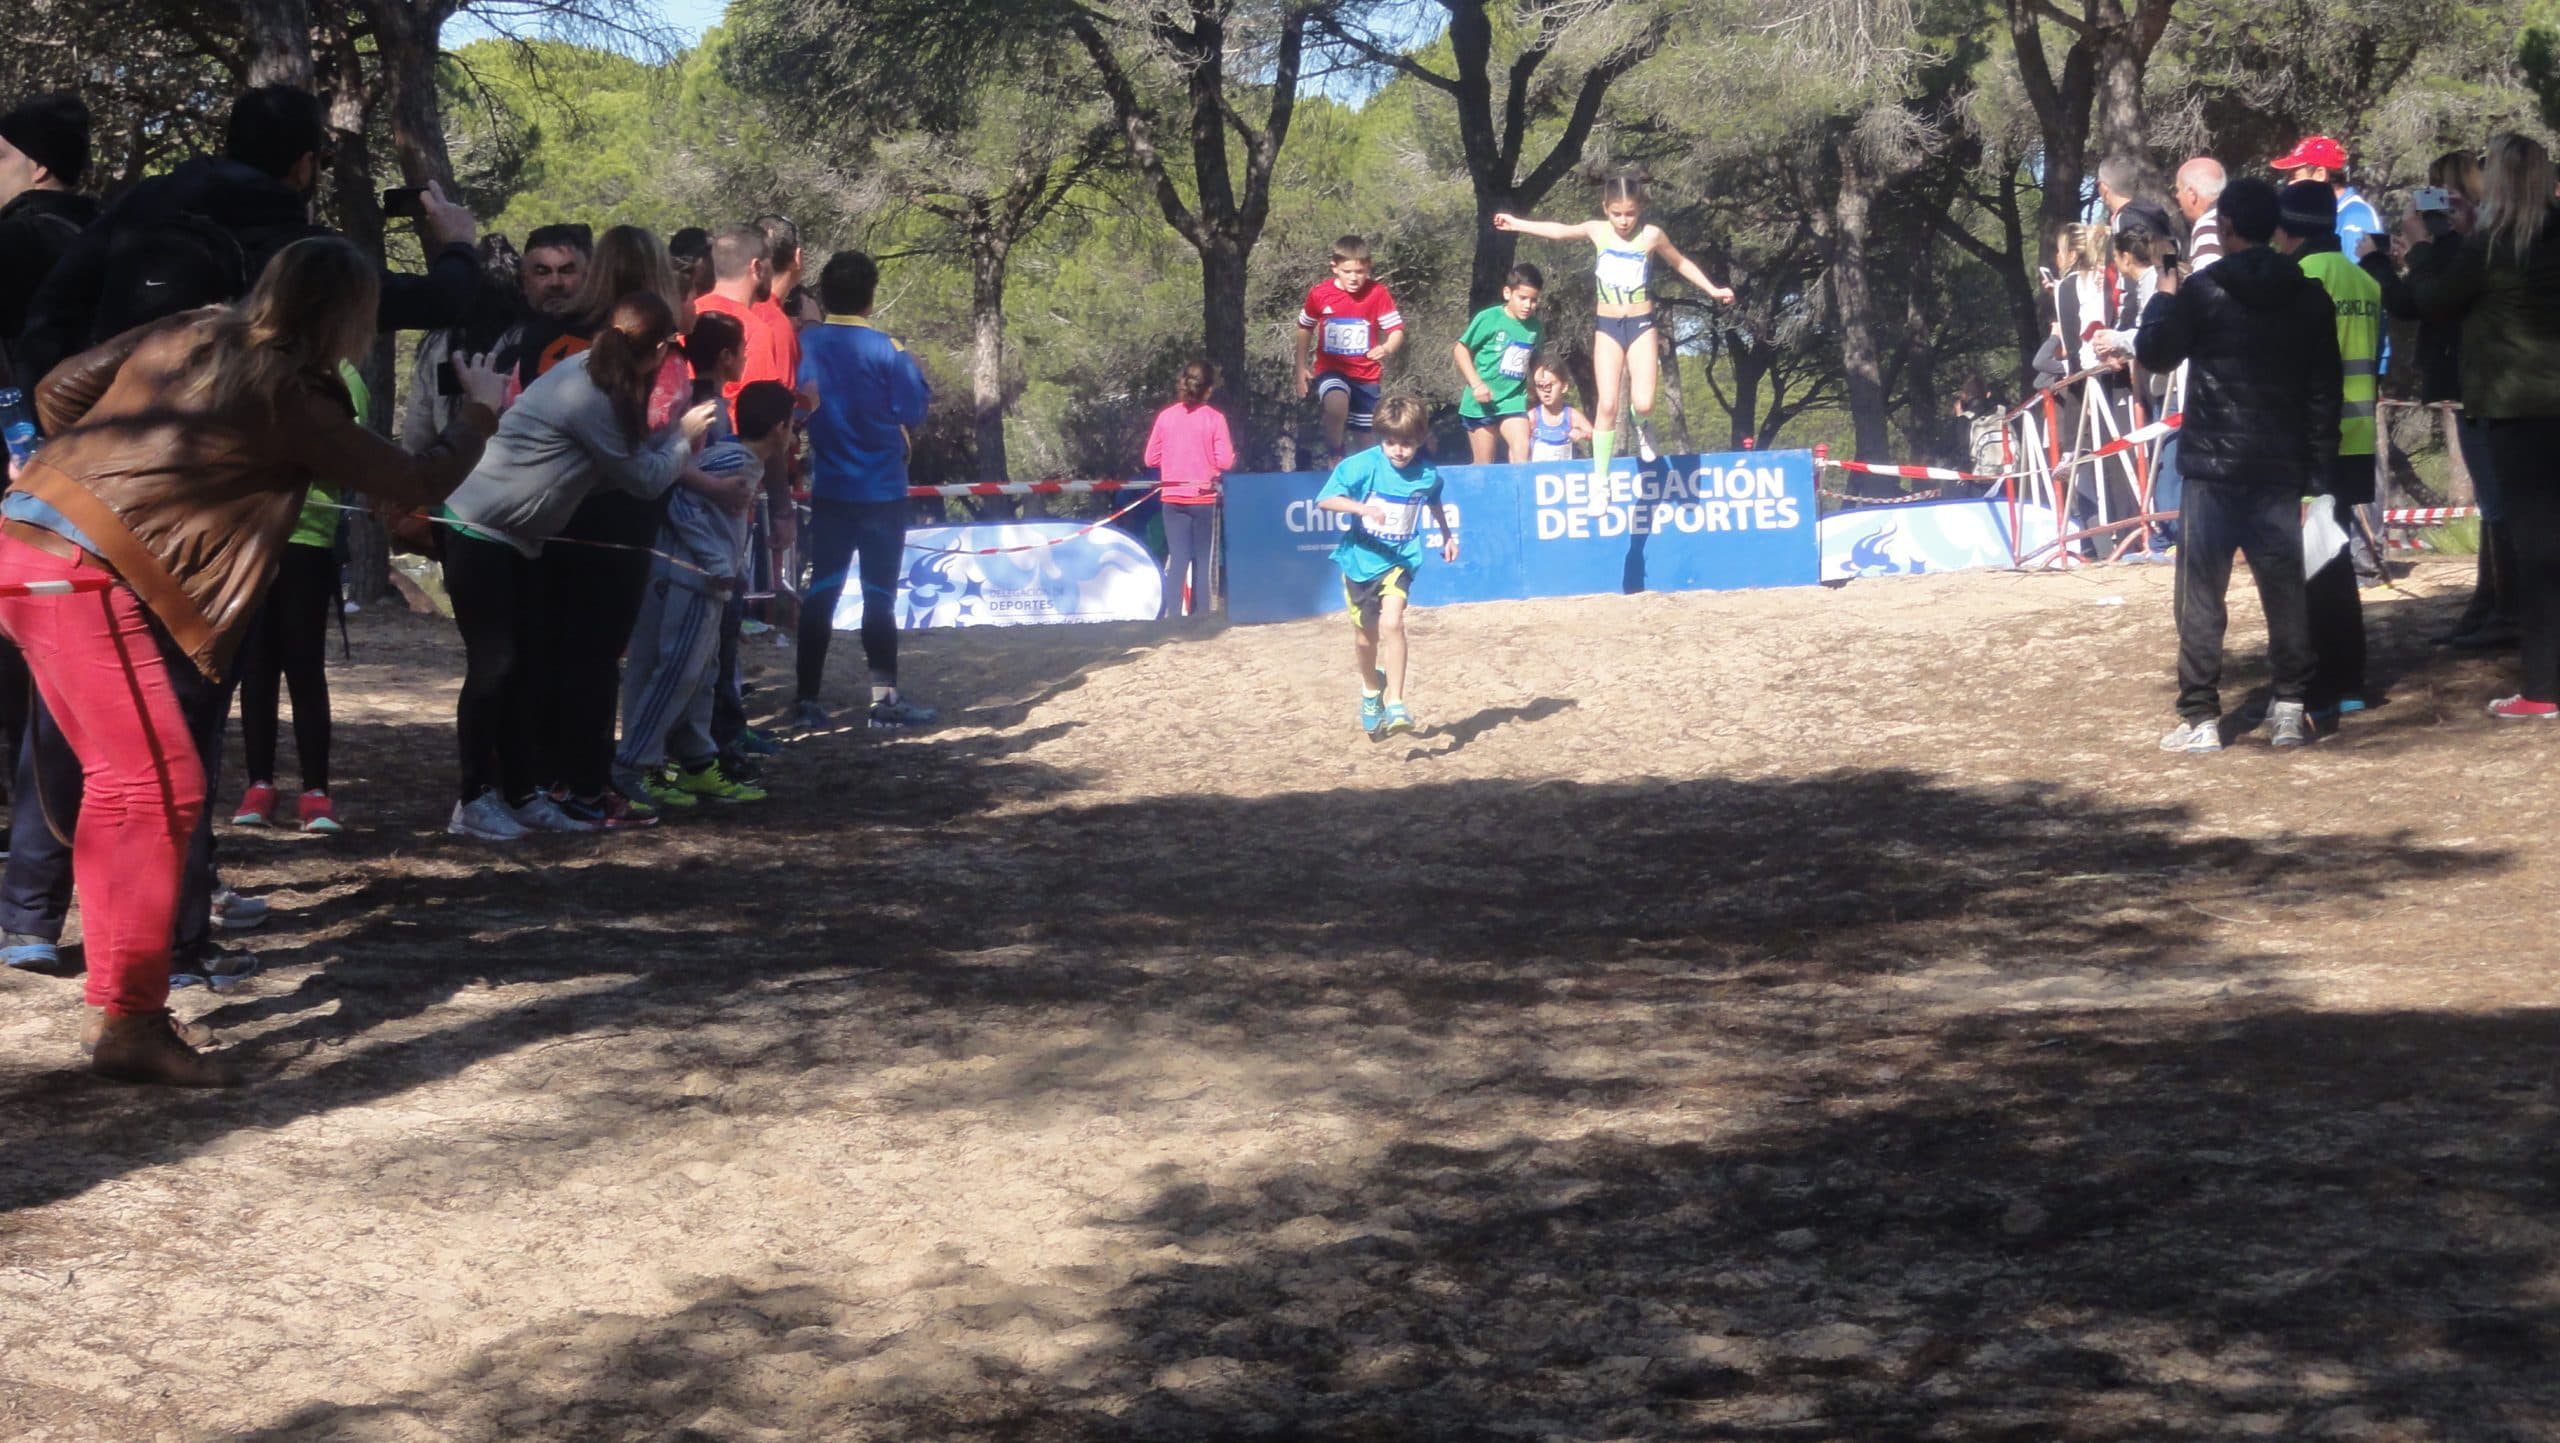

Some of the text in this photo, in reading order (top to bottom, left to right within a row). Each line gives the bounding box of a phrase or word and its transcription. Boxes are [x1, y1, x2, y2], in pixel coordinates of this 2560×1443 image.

[1285, 500, 1460, 532] Chicna
[1537, 497, 1800, 540] DE DEPORTES
[990, 600, 1054, 611] DEPORTES
